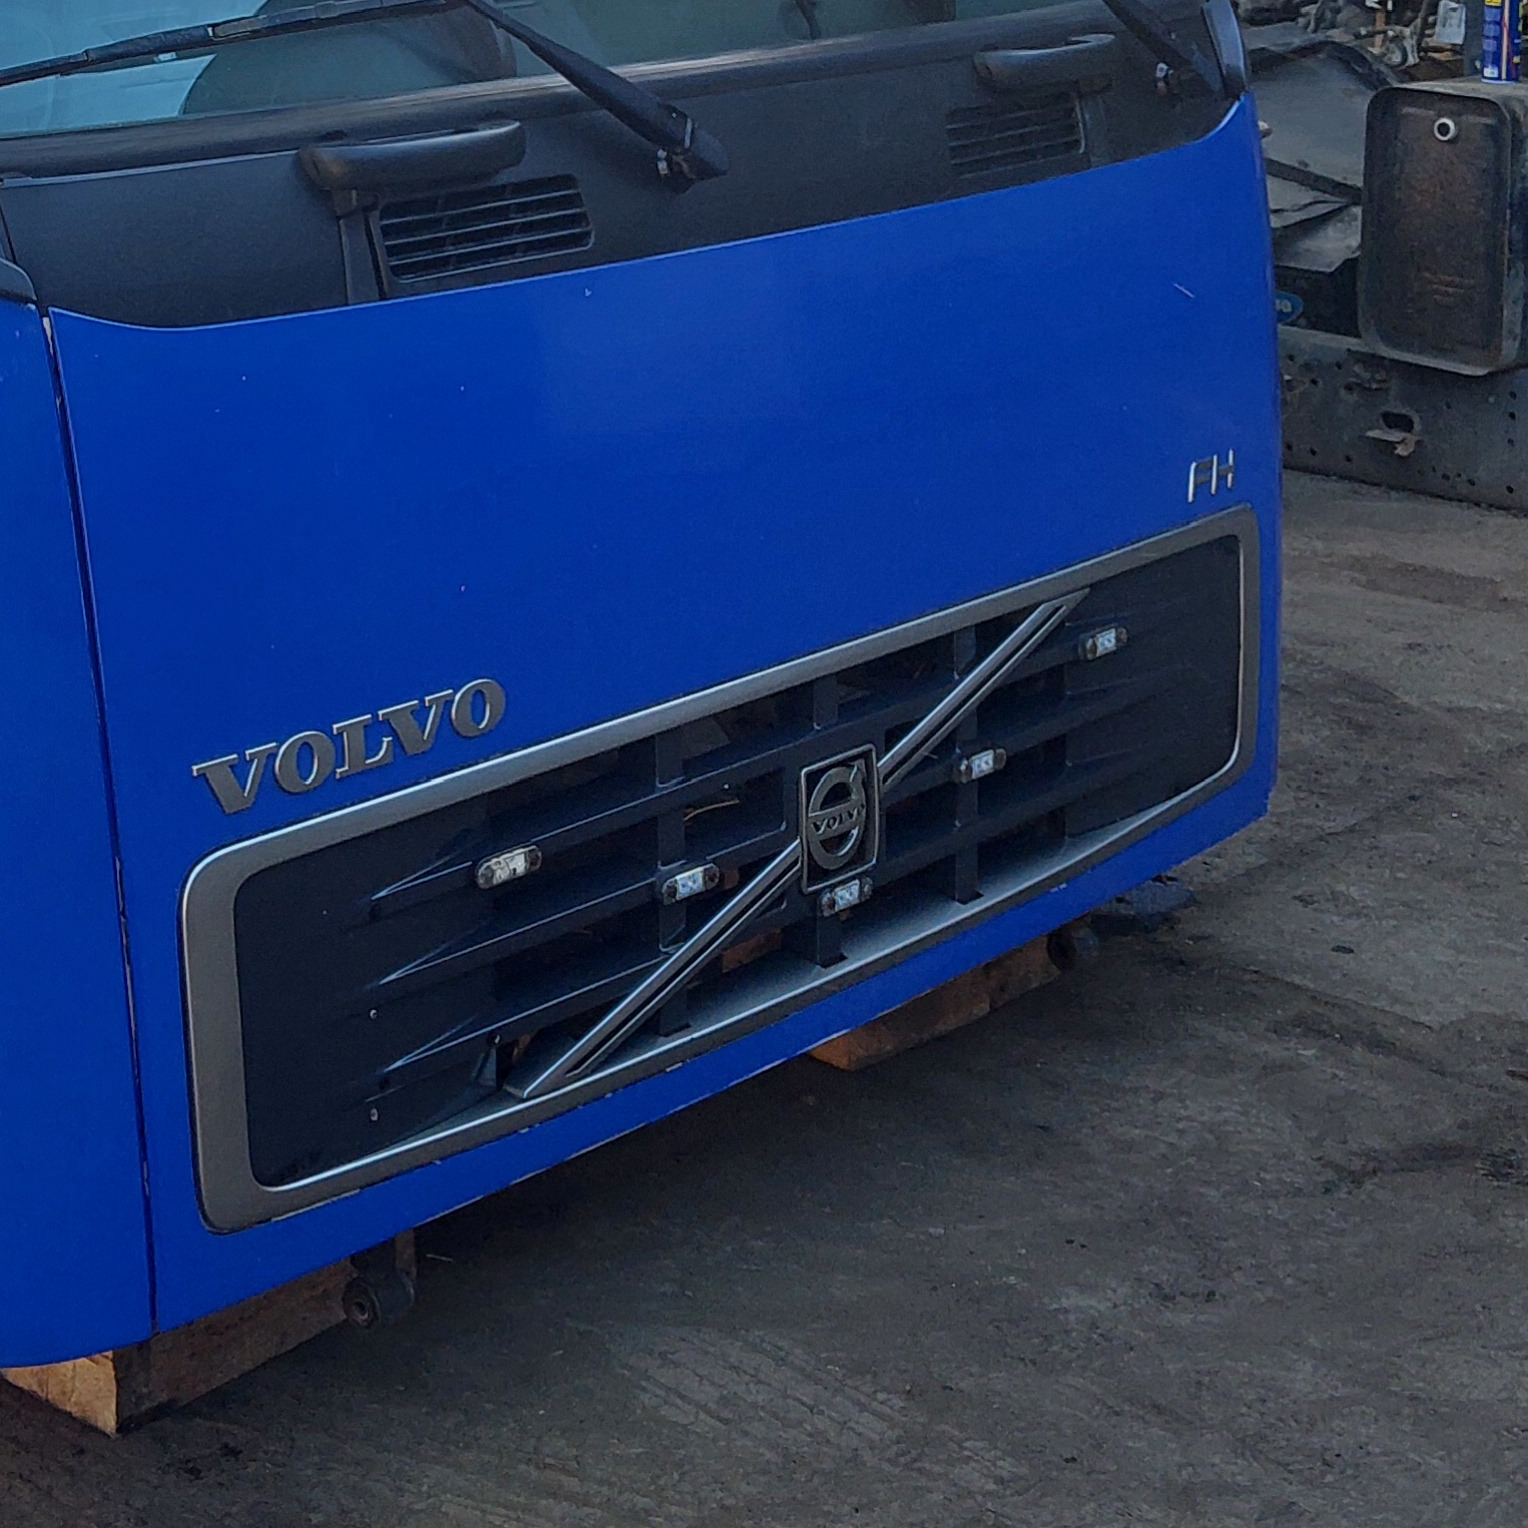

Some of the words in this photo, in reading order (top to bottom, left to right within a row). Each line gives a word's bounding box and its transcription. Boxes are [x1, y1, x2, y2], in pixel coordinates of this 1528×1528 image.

[1187, 448, 1235, 504] FH
[192, 678, 506, 814] VOLVO
[810, 803, 865, 835] VOLVO
